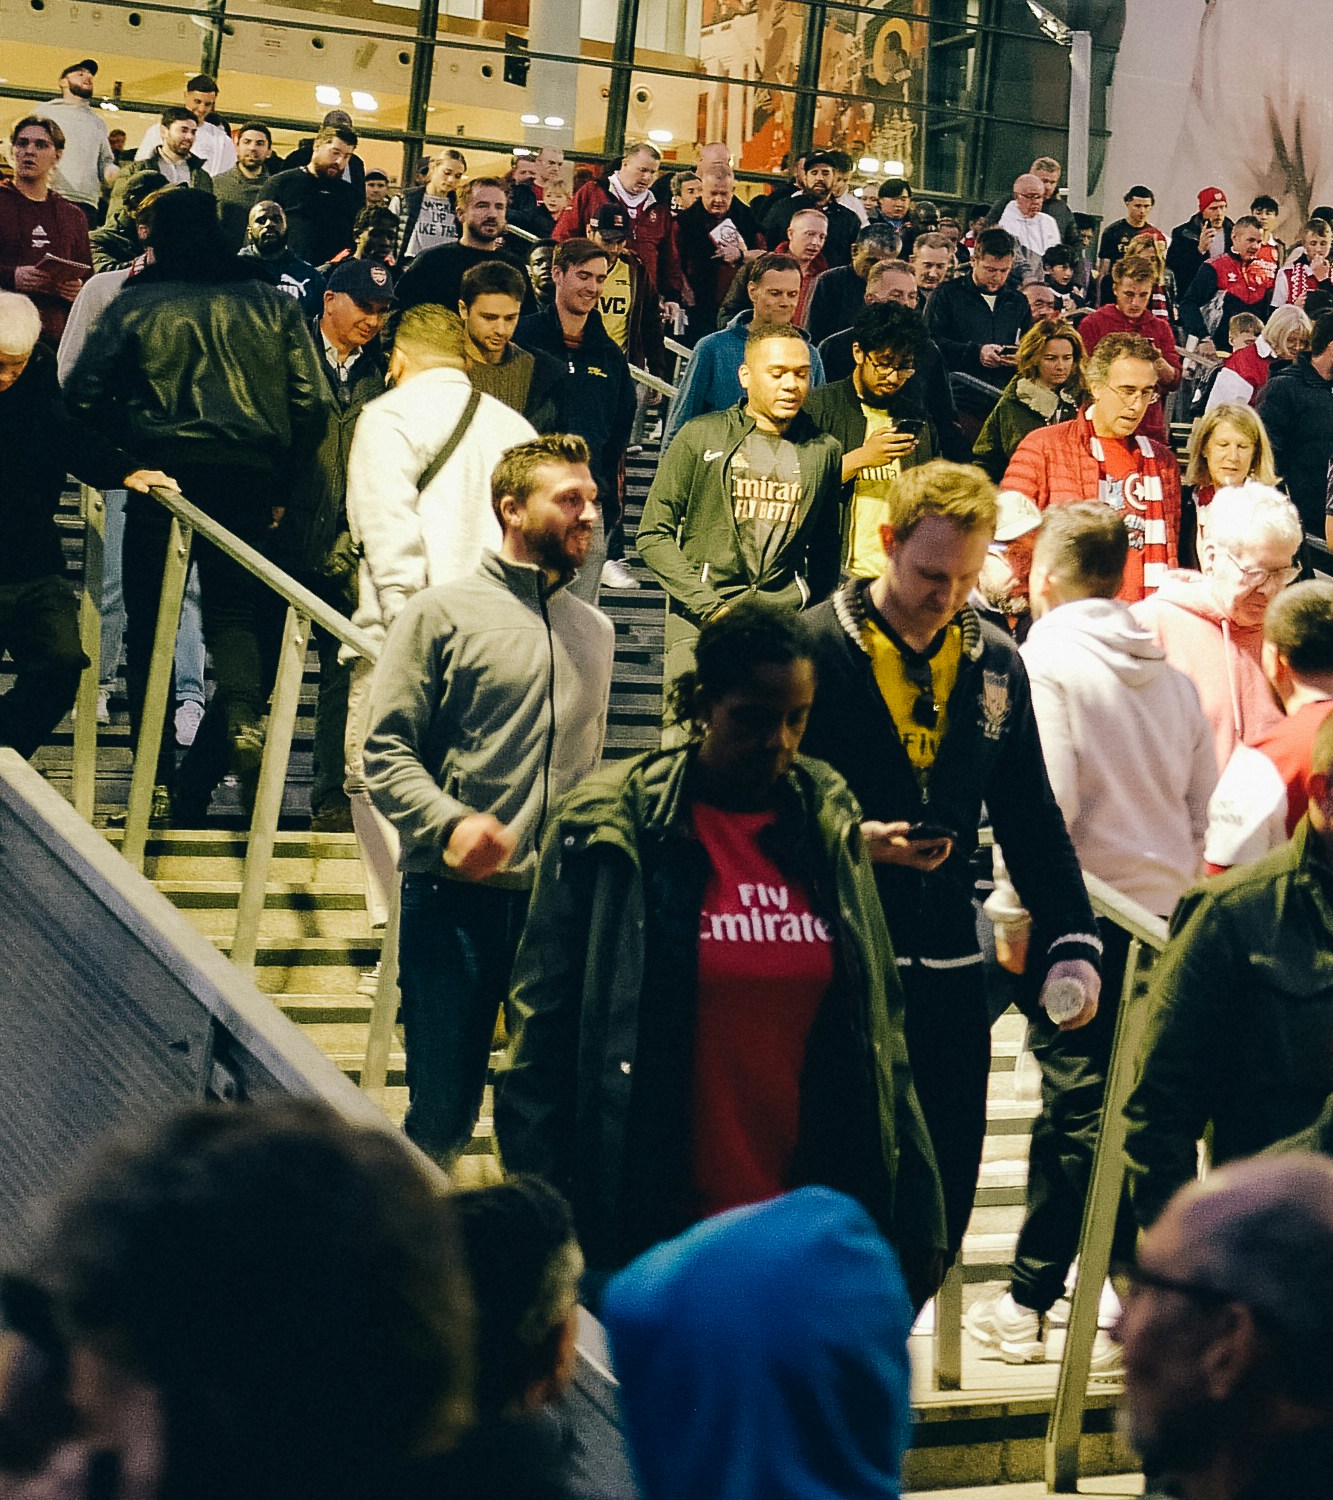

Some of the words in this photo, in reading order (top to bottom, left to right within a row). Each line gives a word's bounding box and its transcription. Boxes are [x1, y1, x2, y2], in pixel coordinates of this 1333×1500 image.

[599, 296, 626, 314] VC
[731, 475, 803, 502] mirat
[738, 883, 788, 911] Fly
[701, 907, 829, 943] mirate
